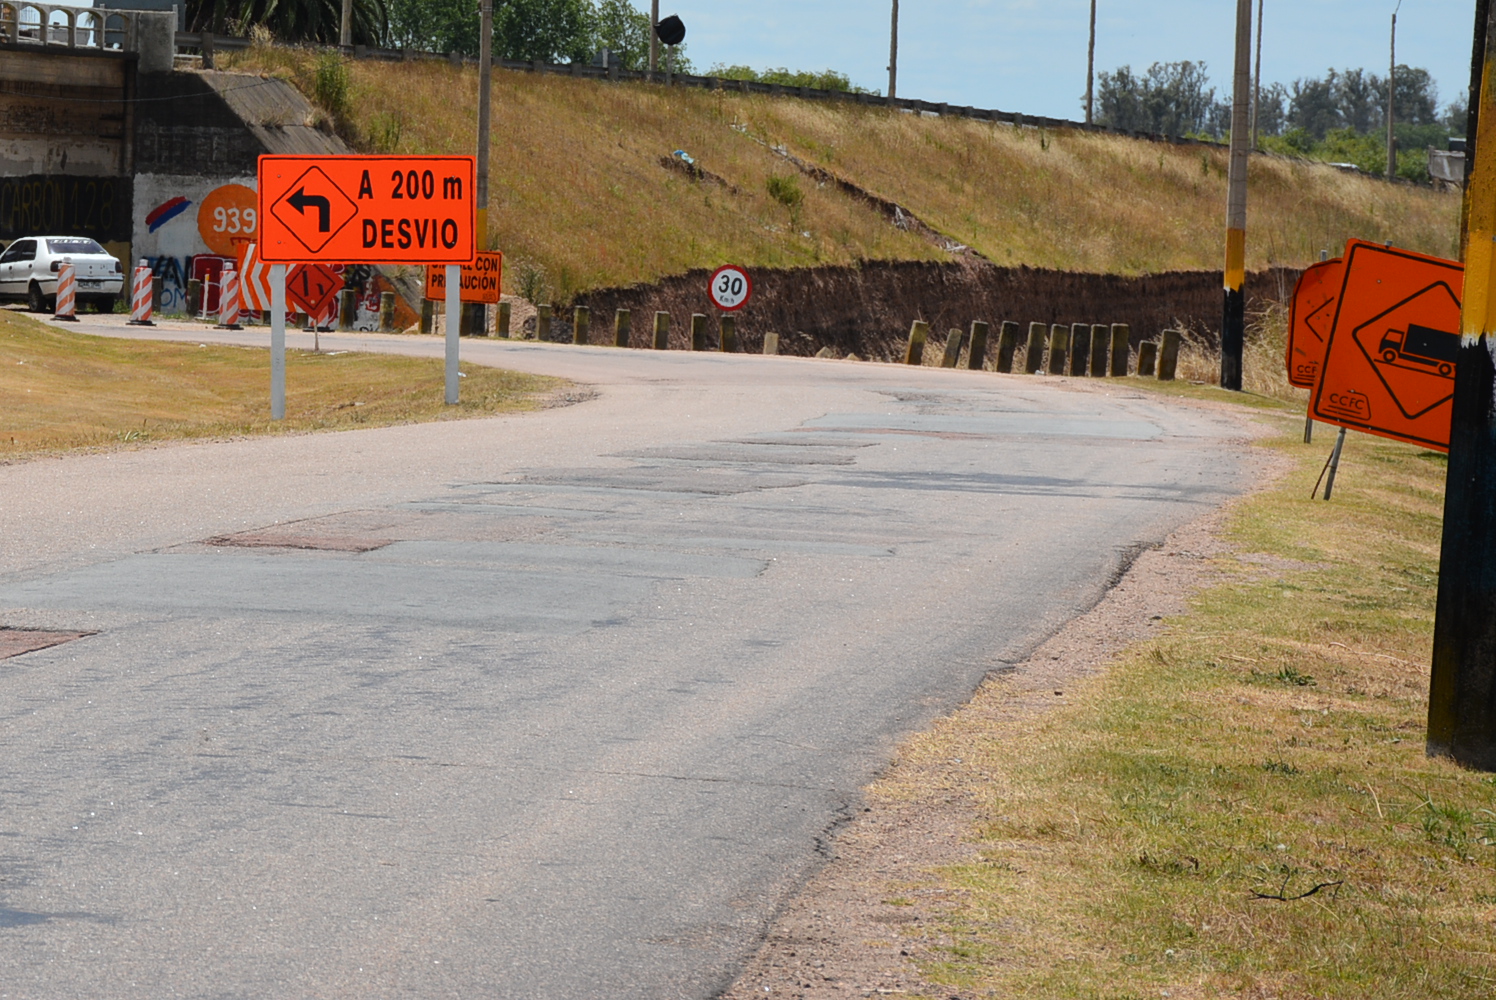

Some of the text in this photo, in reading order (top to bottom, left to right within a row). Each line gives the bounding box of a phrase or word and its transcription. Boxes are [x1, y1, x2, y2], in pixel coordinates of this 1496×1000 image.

[358, 169, 462, 199] A 200 m
[213, 206, 256, 234] 939
[362, 218, 458, 249] DESVIO
[475, 256, 497, 272] CON
[719, 275, 742, 296] 30
[1297, 364, 1317, 374] CCF
[1329, 393, 1365, 410] CCFC
